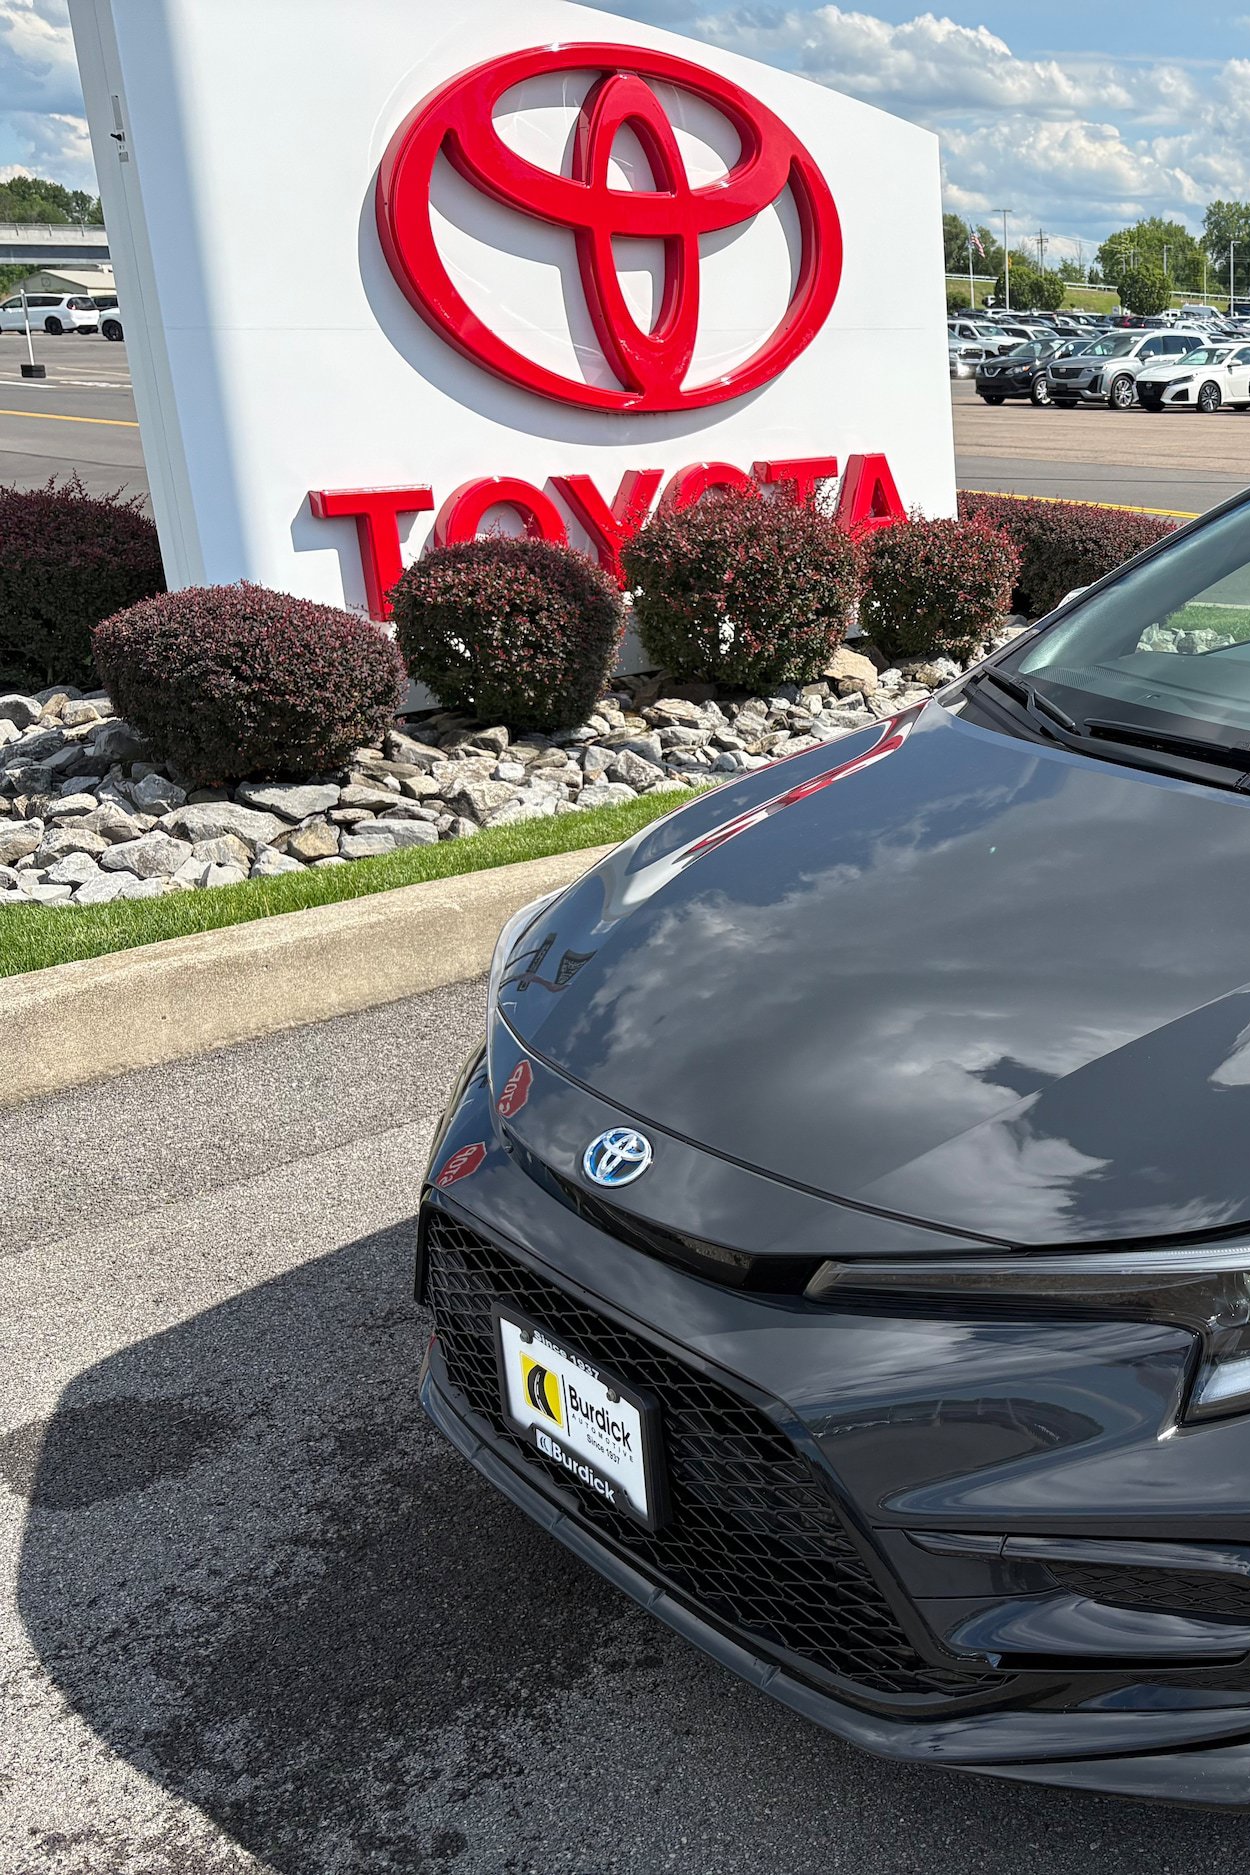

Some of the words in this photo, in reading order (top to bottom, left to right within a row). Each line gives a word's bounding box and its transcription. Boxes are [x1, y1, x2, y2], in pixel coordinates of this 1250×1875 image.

[533, 1330, 568, 1359] Since
[570, 1355, 600, 1380] 1937
[568, 1384, 632, 1453] Burdick
[572, 1413, 634, 1463] AUTOMOTIVE
[552, 1441, 616, 1504] Burdick
[586, 1434, 605, 1454] Since
[605, 1448, 620, 1465] 1937
